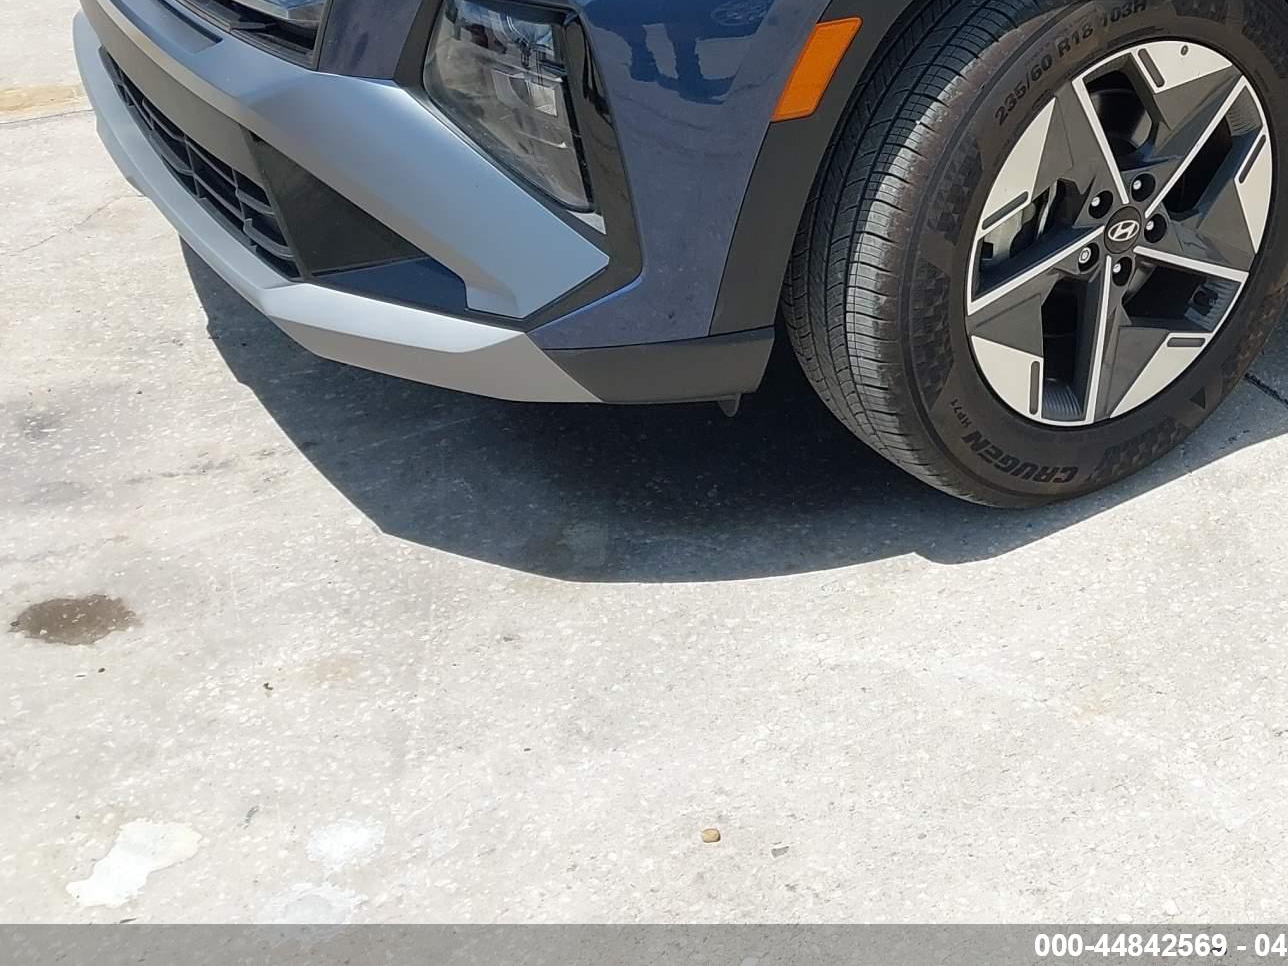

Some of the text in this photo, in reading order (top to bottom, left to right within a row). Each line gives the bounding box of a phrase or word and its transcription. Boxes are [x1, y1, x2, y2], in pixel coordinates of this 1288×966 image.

[995, 55, 1053, 125] 235/60
[1058, 24, 1093, 57] R18
[962, 430, 1079, 483] CRUGEN
